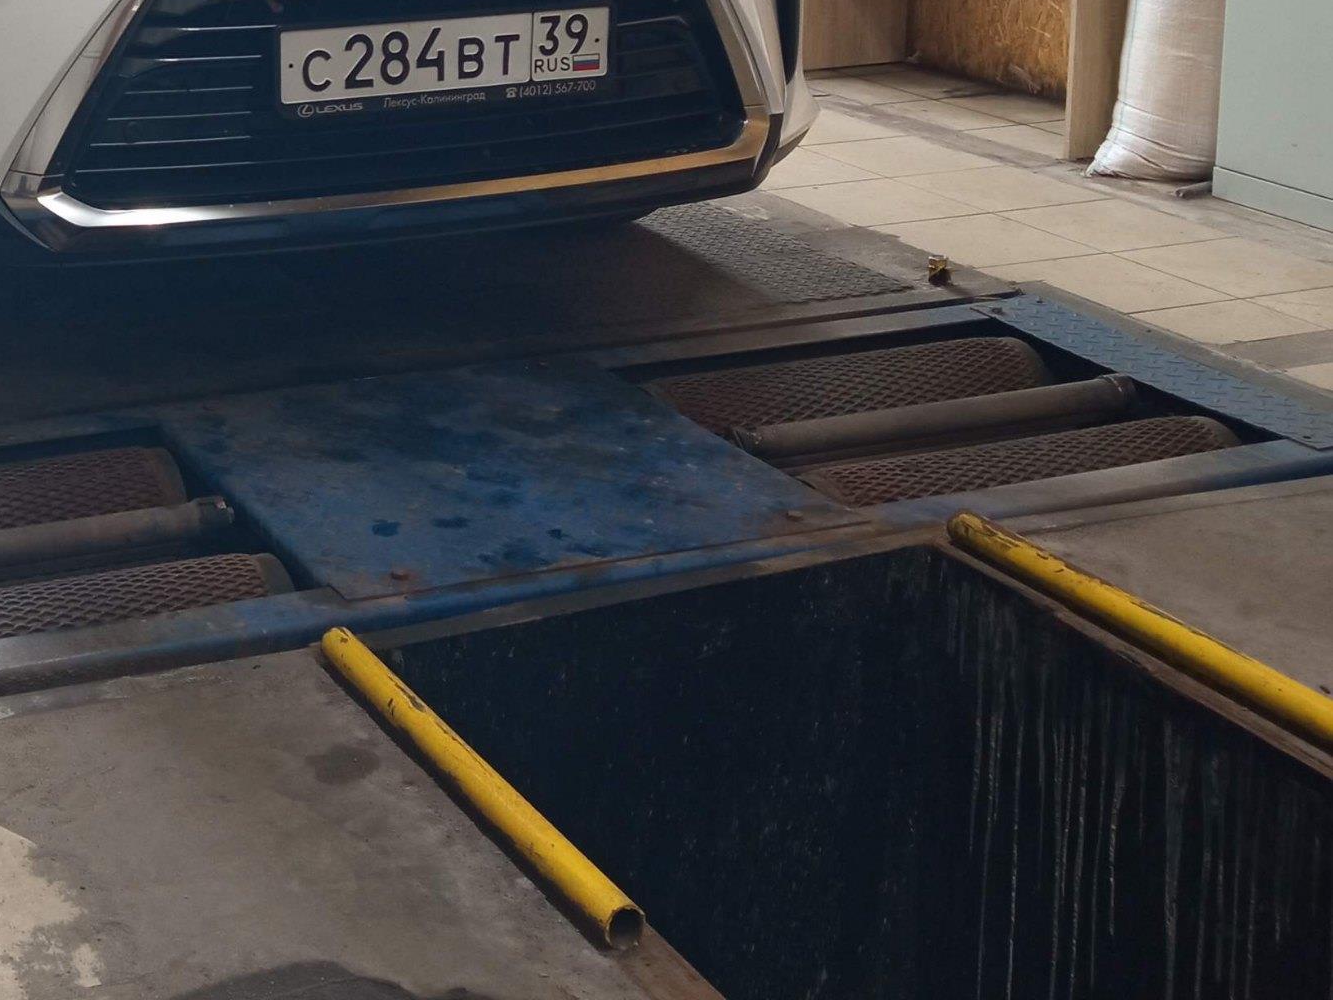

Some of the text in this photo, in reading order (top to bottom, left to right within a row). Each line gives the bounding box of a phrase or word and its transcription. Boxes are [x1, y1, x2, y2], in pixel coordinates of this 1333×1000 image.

[538, 13, 589, 57] 39
[533, 57, 571, 74] RUS
[519, 80, 597, 98] (4012) 567-700
[315, 101, 364, 114] LEXUS
